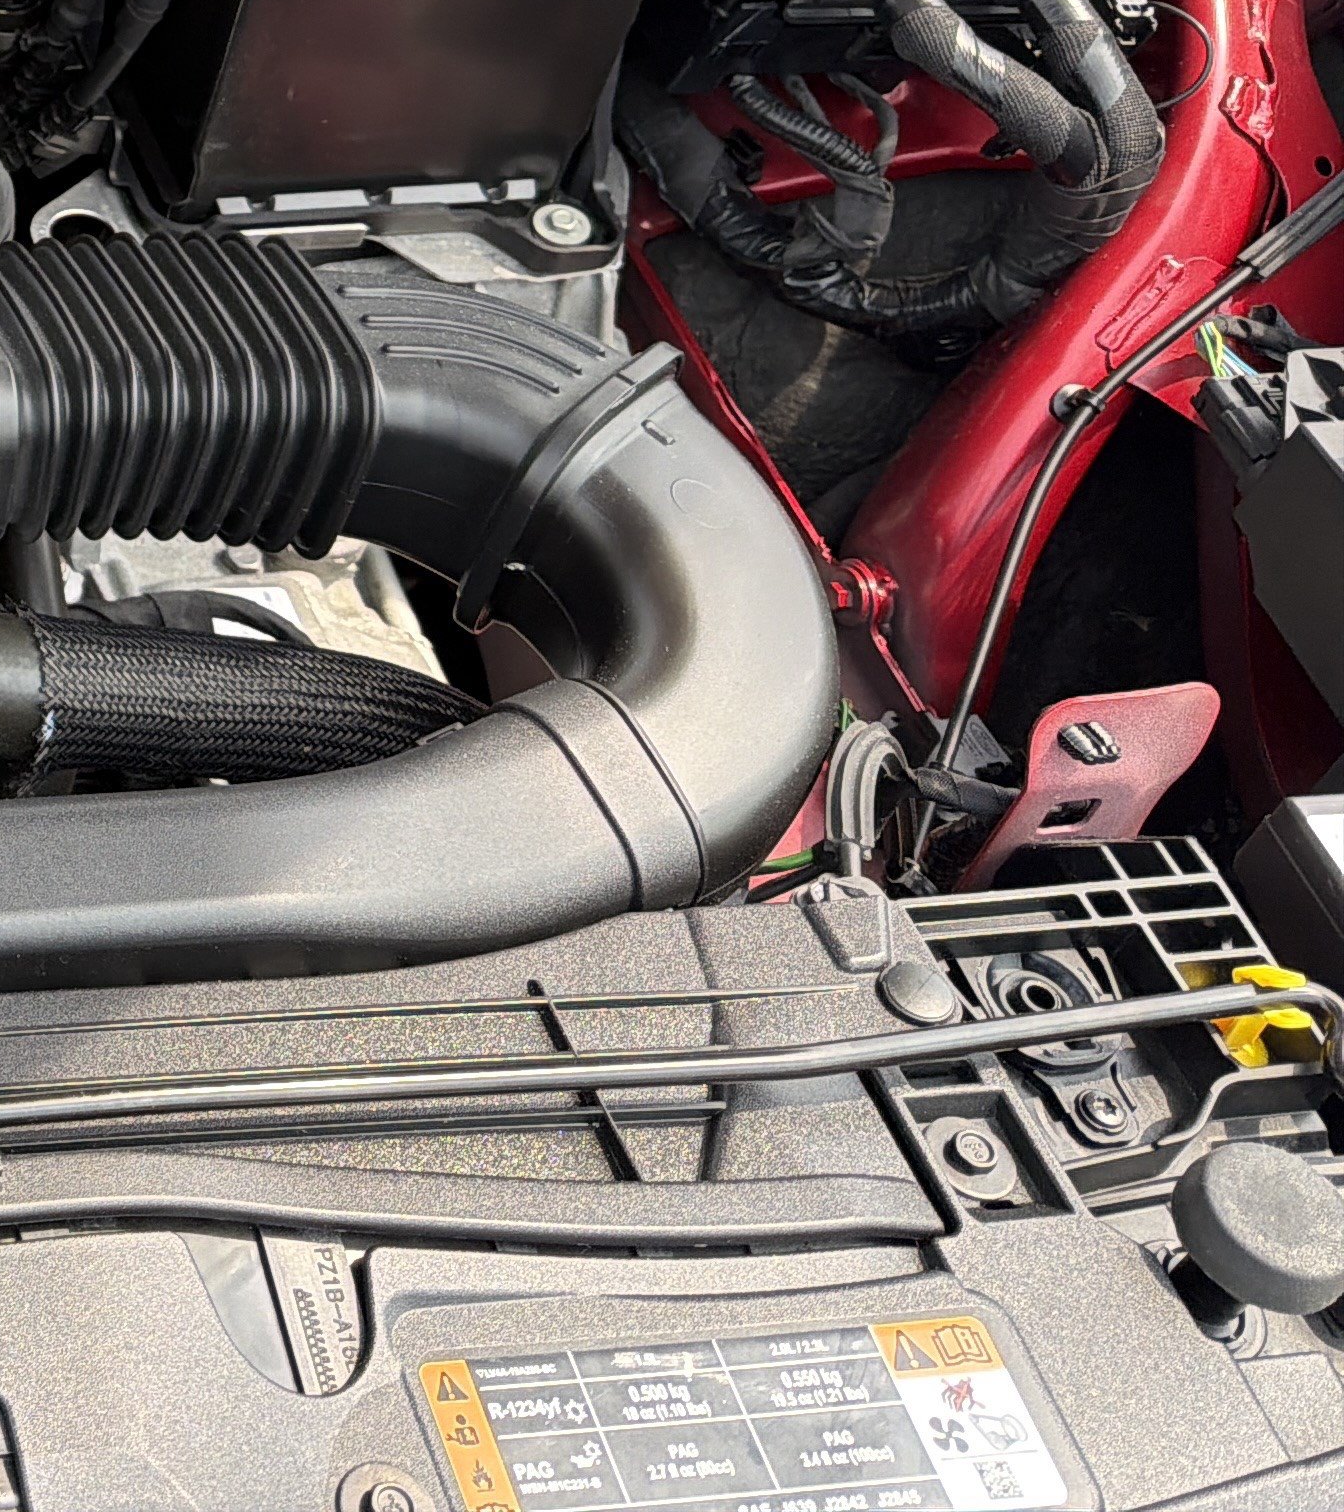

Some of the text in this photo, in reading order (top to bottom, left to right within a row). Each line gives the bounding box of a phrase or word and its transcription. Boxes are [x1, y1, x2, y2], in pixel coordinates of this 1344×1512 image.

[779, 1368, 844, 1389] 0.550 kg
[628, 1382, 692, 1404] 0.500 kg
[797, 1390, 815, 1406] oz
[487, 1395, 563, 1420] R-1234yf
[639, 1405, 657, 1419] oz
[822, 1429, 855, 1448] PAG
[667, 1442, 700, 1460] PAG
[512, 1460, 555, 1481] PAG
